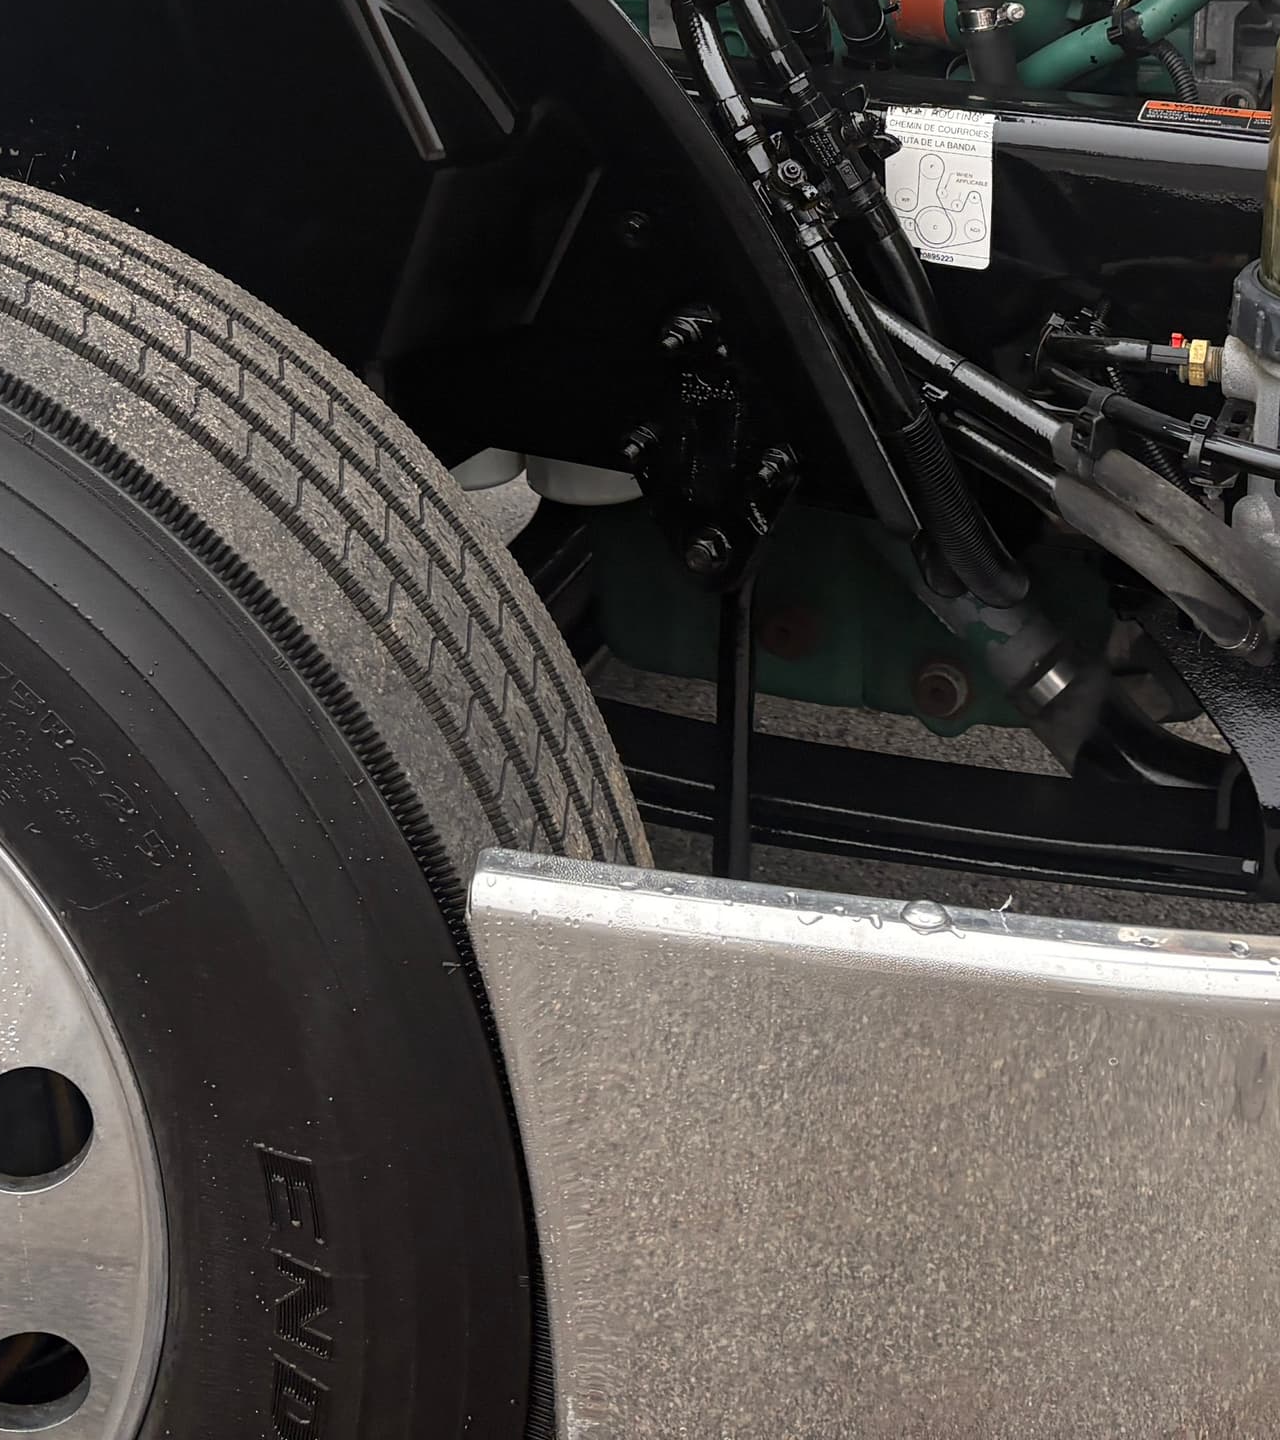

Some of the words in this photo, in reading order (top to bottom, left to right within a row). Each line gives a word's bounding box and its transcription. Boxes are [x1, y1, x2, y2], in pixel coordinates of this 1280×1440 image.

[889, 118, 921, 130] CHEMIN
[923, 123, 936, 133] DE
[937, 125, 991, 139] COURROIES
[920, 137, 933, 147] DE
[934, 139, 946, 149] LA
[947, 141, 977, 152] BANDA
[956, 178, 988, 187] APPLICABLE
